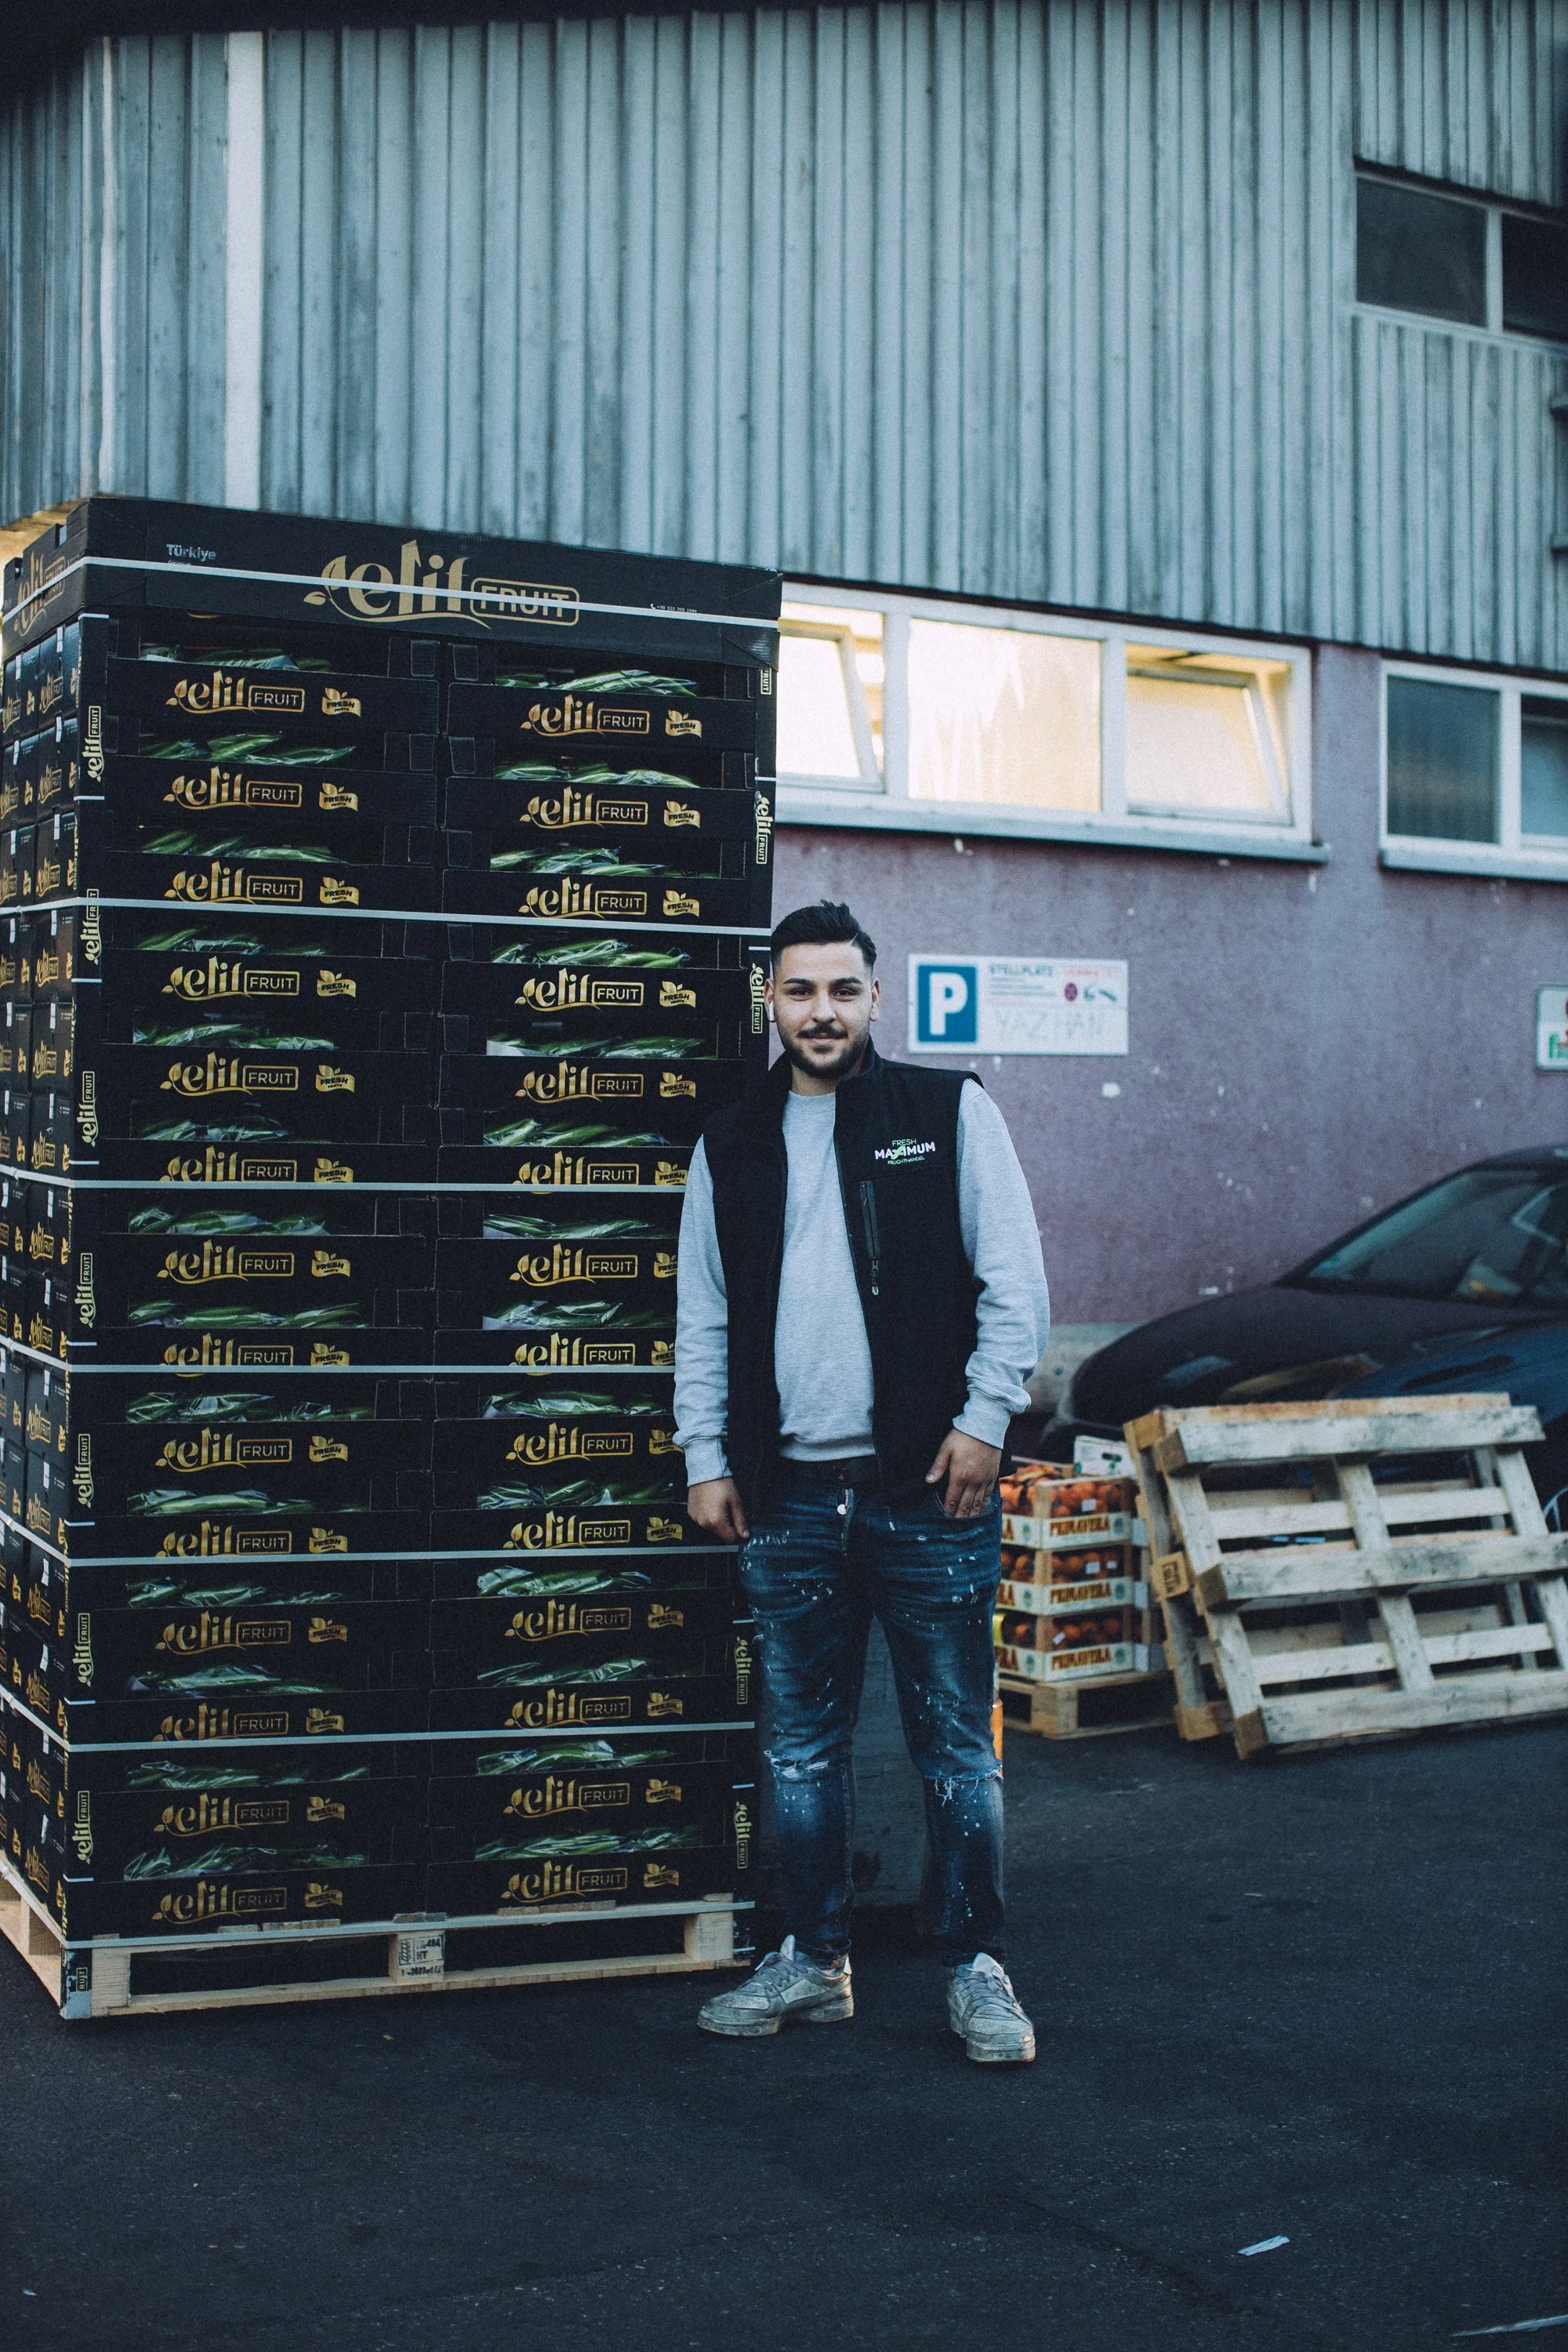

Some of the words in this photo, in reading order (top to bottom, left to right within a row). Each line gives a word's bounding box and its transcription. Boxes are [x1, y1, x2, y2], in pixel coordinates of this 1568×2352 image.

[166, 544, 216, 561] Türkiye
[481, 586, 569, 618] FRUIT
[254, 692, 299, 706] FRUIT
[603, 715, 644, 728] FRUIT
[252, 788, 296, 800] FRUIT
[601, 808, 643, 818] FRUIT
[252, 883, 297, 895] FRUIT
[600, 898, 641, 909] FRUIT
[250, 977, 294, 989] FRUIT
[597, 989, 638, 1000] FRUIT
[929, 972, 967, 1035] P
[249, 1073, 293, 1083] FRUIT
[597, 1080, 639, 1091] FRUIT
[874, 1142, 936, 1160] MAXIMUM
[887, 1156, 925, 1165] FRUCHTHANDEL
[247, 1166, 291, 1177] FRUIT
[592, 1170, 633, 1180] FRUIT
[245, 1259, 289, 1270] FRUIT
[591, 1261, 633, 1272] FRUIT
[244, 1352, 288, 1363] FRUIT
[589, 1350, 630, 1360] FRUIT
[586, 1439, 628, 1450] FRUIT
[242, 1445, 287, 1457] FRUIT
[584, 1526, 626, 1537] FRUIT
[242, 1537, 286, 1548] FRUIT
[586, 1613, 626, 1625] FRUIT
[241, 1627, 286, 1639] FRUIT
[585, 1702, 626, 1714] FRUIT
[240, 1717, 284, 1730] FRUIT
[584, 1789, 625, 1801] FRUIT
[240, 1806, 285, 1819] FRUIT
[582, 1874, 622, 1886] FRUIT
[238, 1893, 282, 1906] FRUIT
